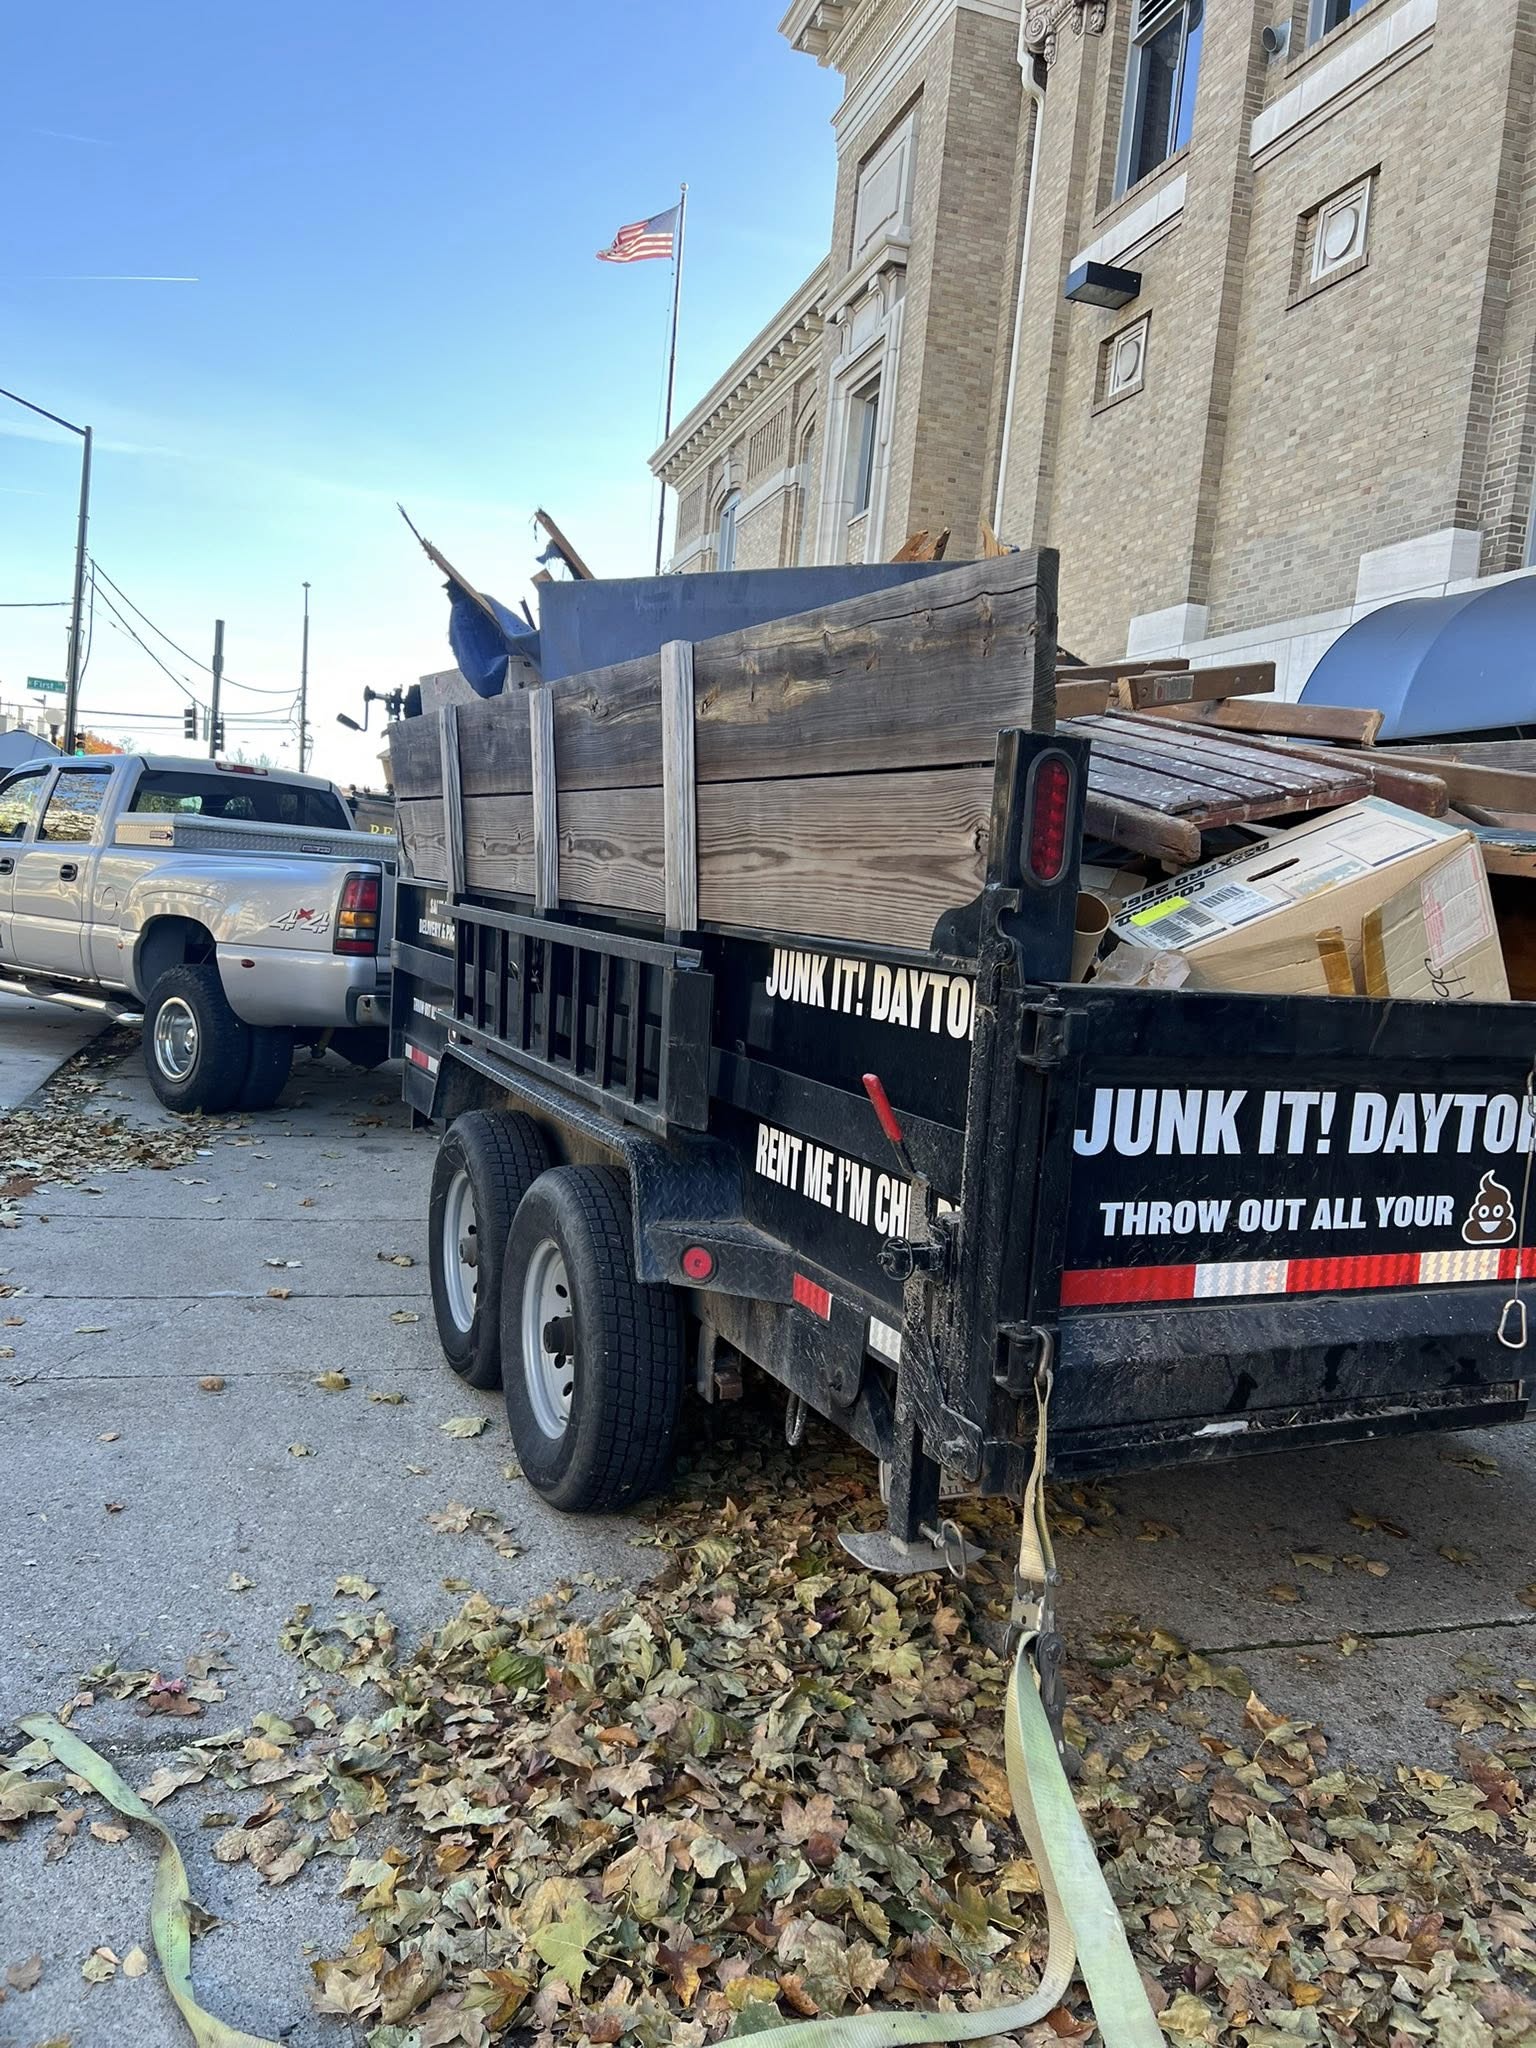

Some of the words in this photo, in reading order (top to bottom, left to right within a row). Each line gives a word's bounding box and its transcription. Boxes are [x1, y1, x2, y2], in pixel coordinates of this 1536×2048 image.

[33, 680, 54, 689] First
[765, 948, 828, 1008] JUNK
[830, 958, 867, 1016] IT!
[1073, 1088, 1248, 1156] JUNK
[1258, 1091, 1337, 1154] IT!
[755, 1122, 803, 1191] RENT
[803, 1142, 834, 1208] ME
[835, 1156, 871, 1227] I'M
[1099, 1200, 1232, 1236] THROW
[1238, 1198, 1307, 1232] OUT
[1311, 1197, 1367, 1231] ALL
[1376, 1195, 1455, 1228] YOUR
